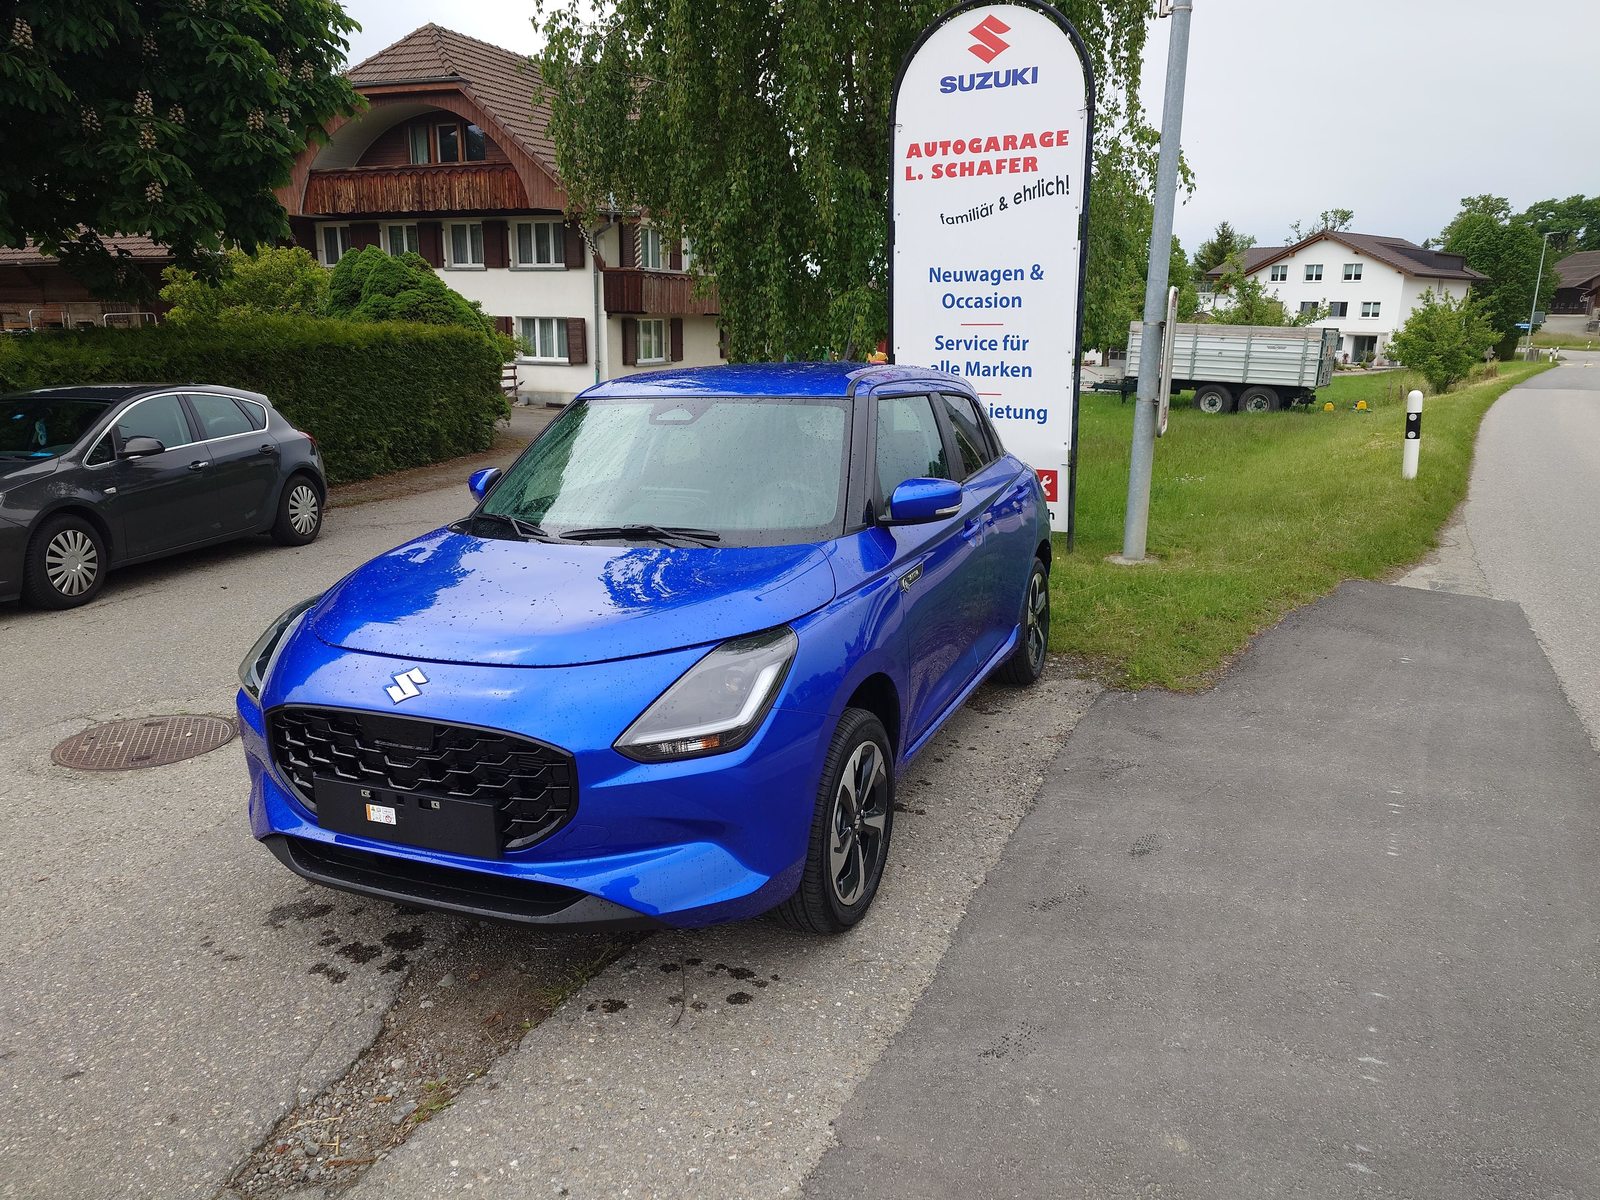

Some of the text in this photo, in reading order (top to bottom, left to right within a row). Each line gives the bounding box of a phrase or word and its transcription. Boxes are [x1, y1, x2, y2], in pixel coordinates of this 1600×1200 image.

[940, 66, 1039, 94] SUZUKI
[906, 130, 1070, 159] AUTOGARAGE
[905, 156, 1039, 181] L. SCHAFER
[940, 174, 1070, 225] familiär & ehrlich!
[929, 263, 1045, 286] Neuwagen &
[942, 292, 1023, 309] Occasion
[934, 334, 1030, 351] Service für
[965, 360, 1033, 378] Marken
[985, 402, 1048, 425] ietung
